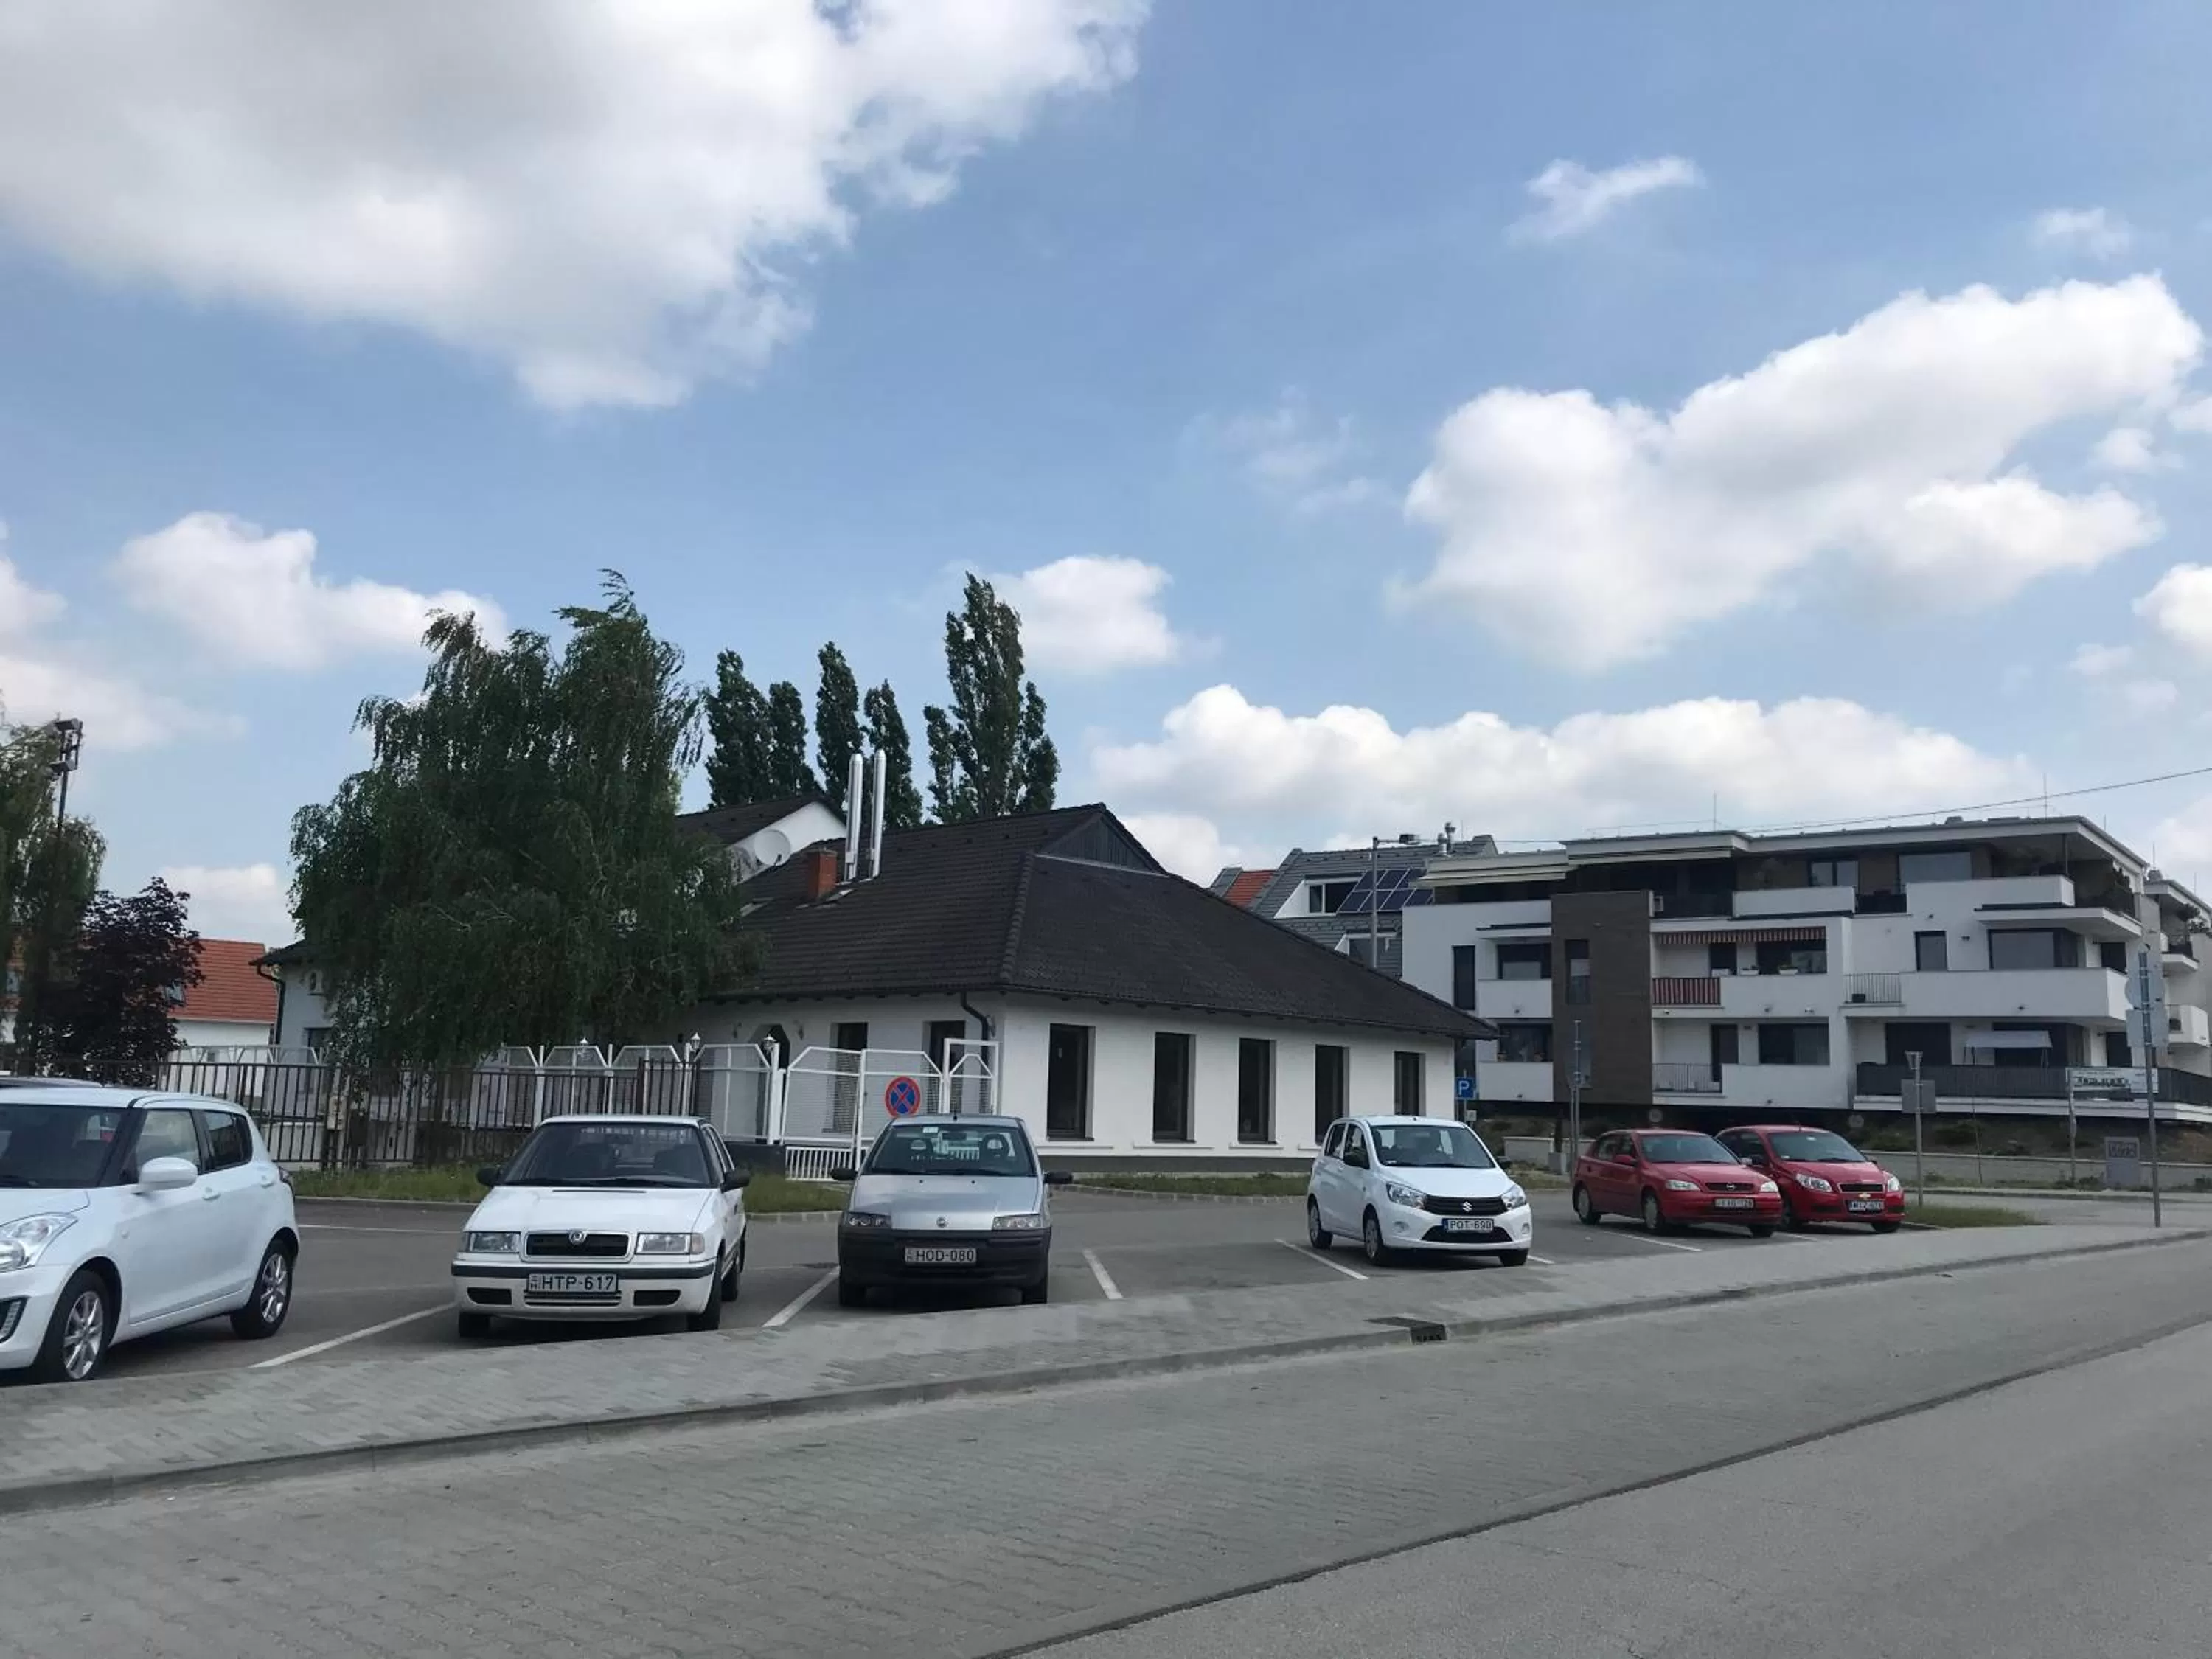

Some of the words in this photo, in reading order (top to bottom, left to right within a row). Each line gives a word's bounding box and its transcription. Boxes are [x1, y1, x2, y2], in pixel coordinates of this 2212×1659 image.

[1459, 1080, 1470, 1095] P
[916, 1250, 974, 1262] HOD-080
[542, 1275, 614, 1290] HTP-617
